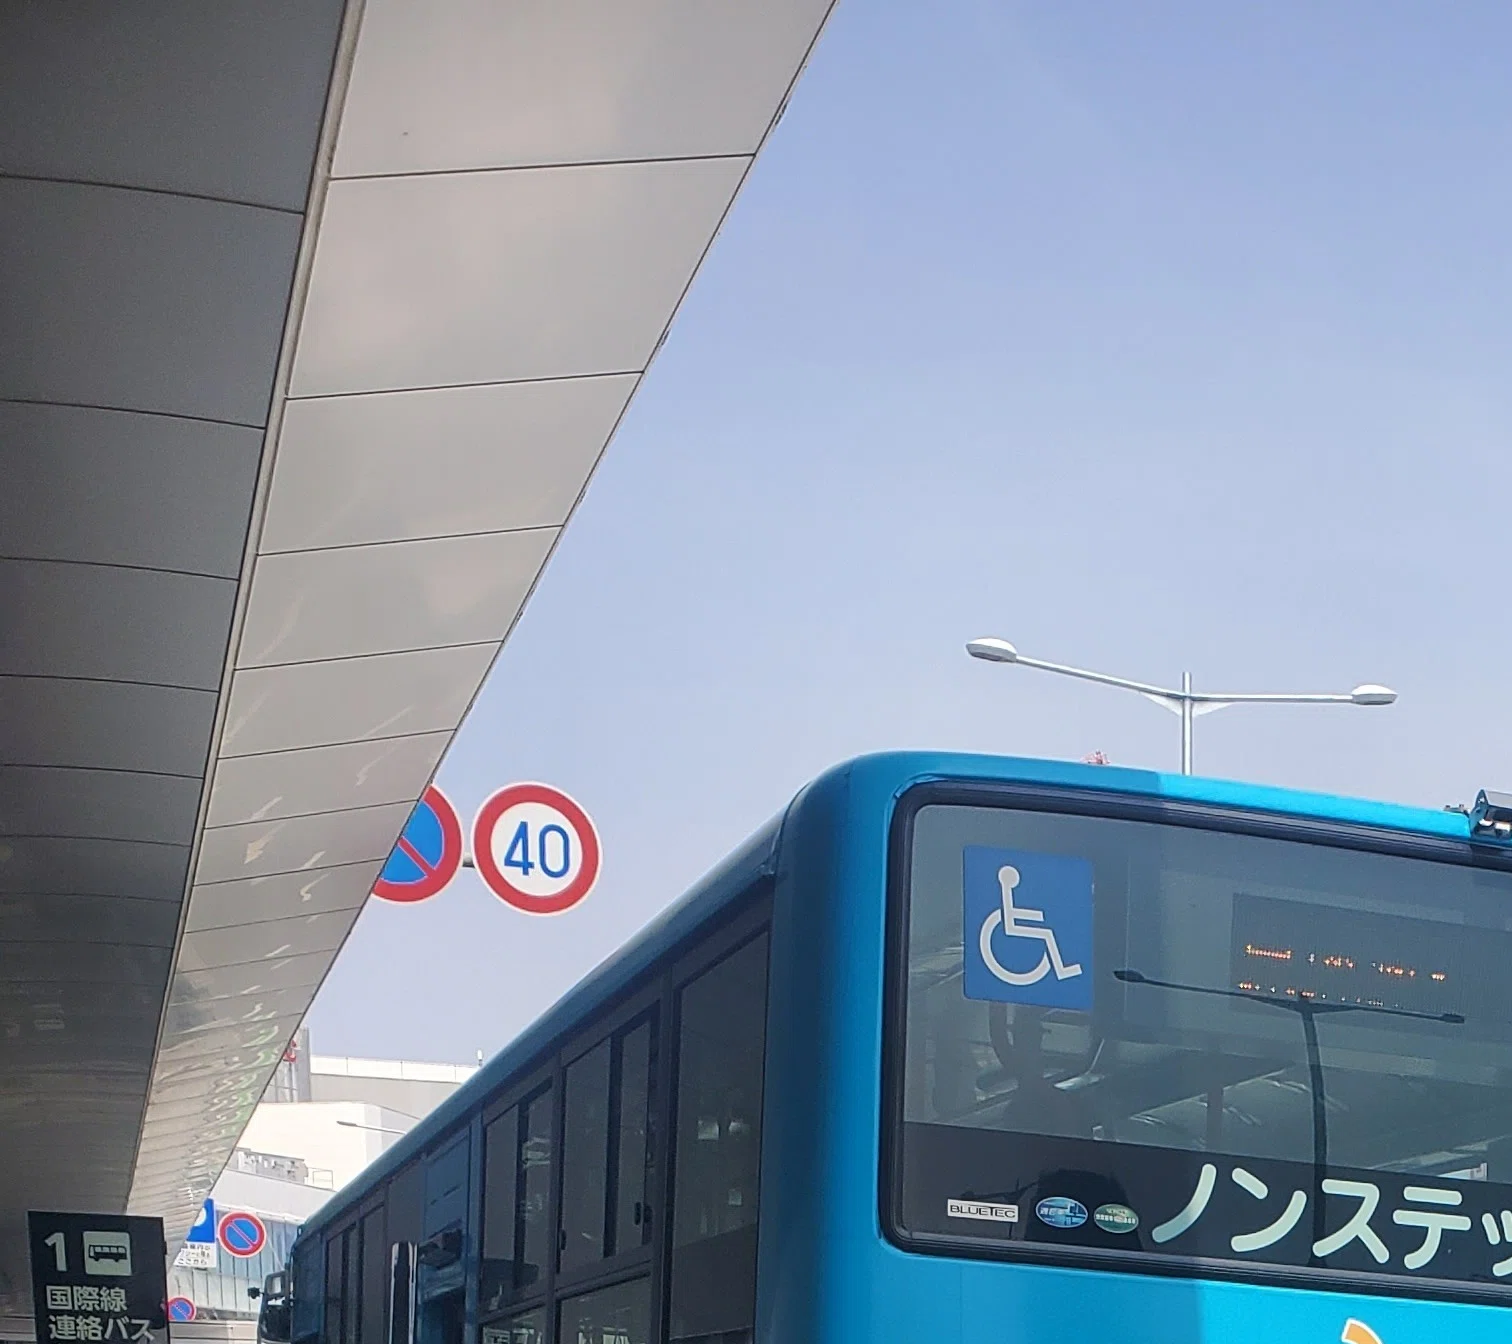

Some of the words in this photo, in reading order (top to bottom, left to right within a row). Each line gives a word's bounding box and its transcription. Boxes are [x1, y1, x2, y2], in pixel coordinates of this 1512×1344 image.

[503, 821, 571, 878] 40
[950, 1205, 1015, 1218] BLUETEC
[45, 1232, 67, 1272] 1
[46, 1285, 128, 1312] 国際線
[48, 1315, 155, 1341] 連絡バス
